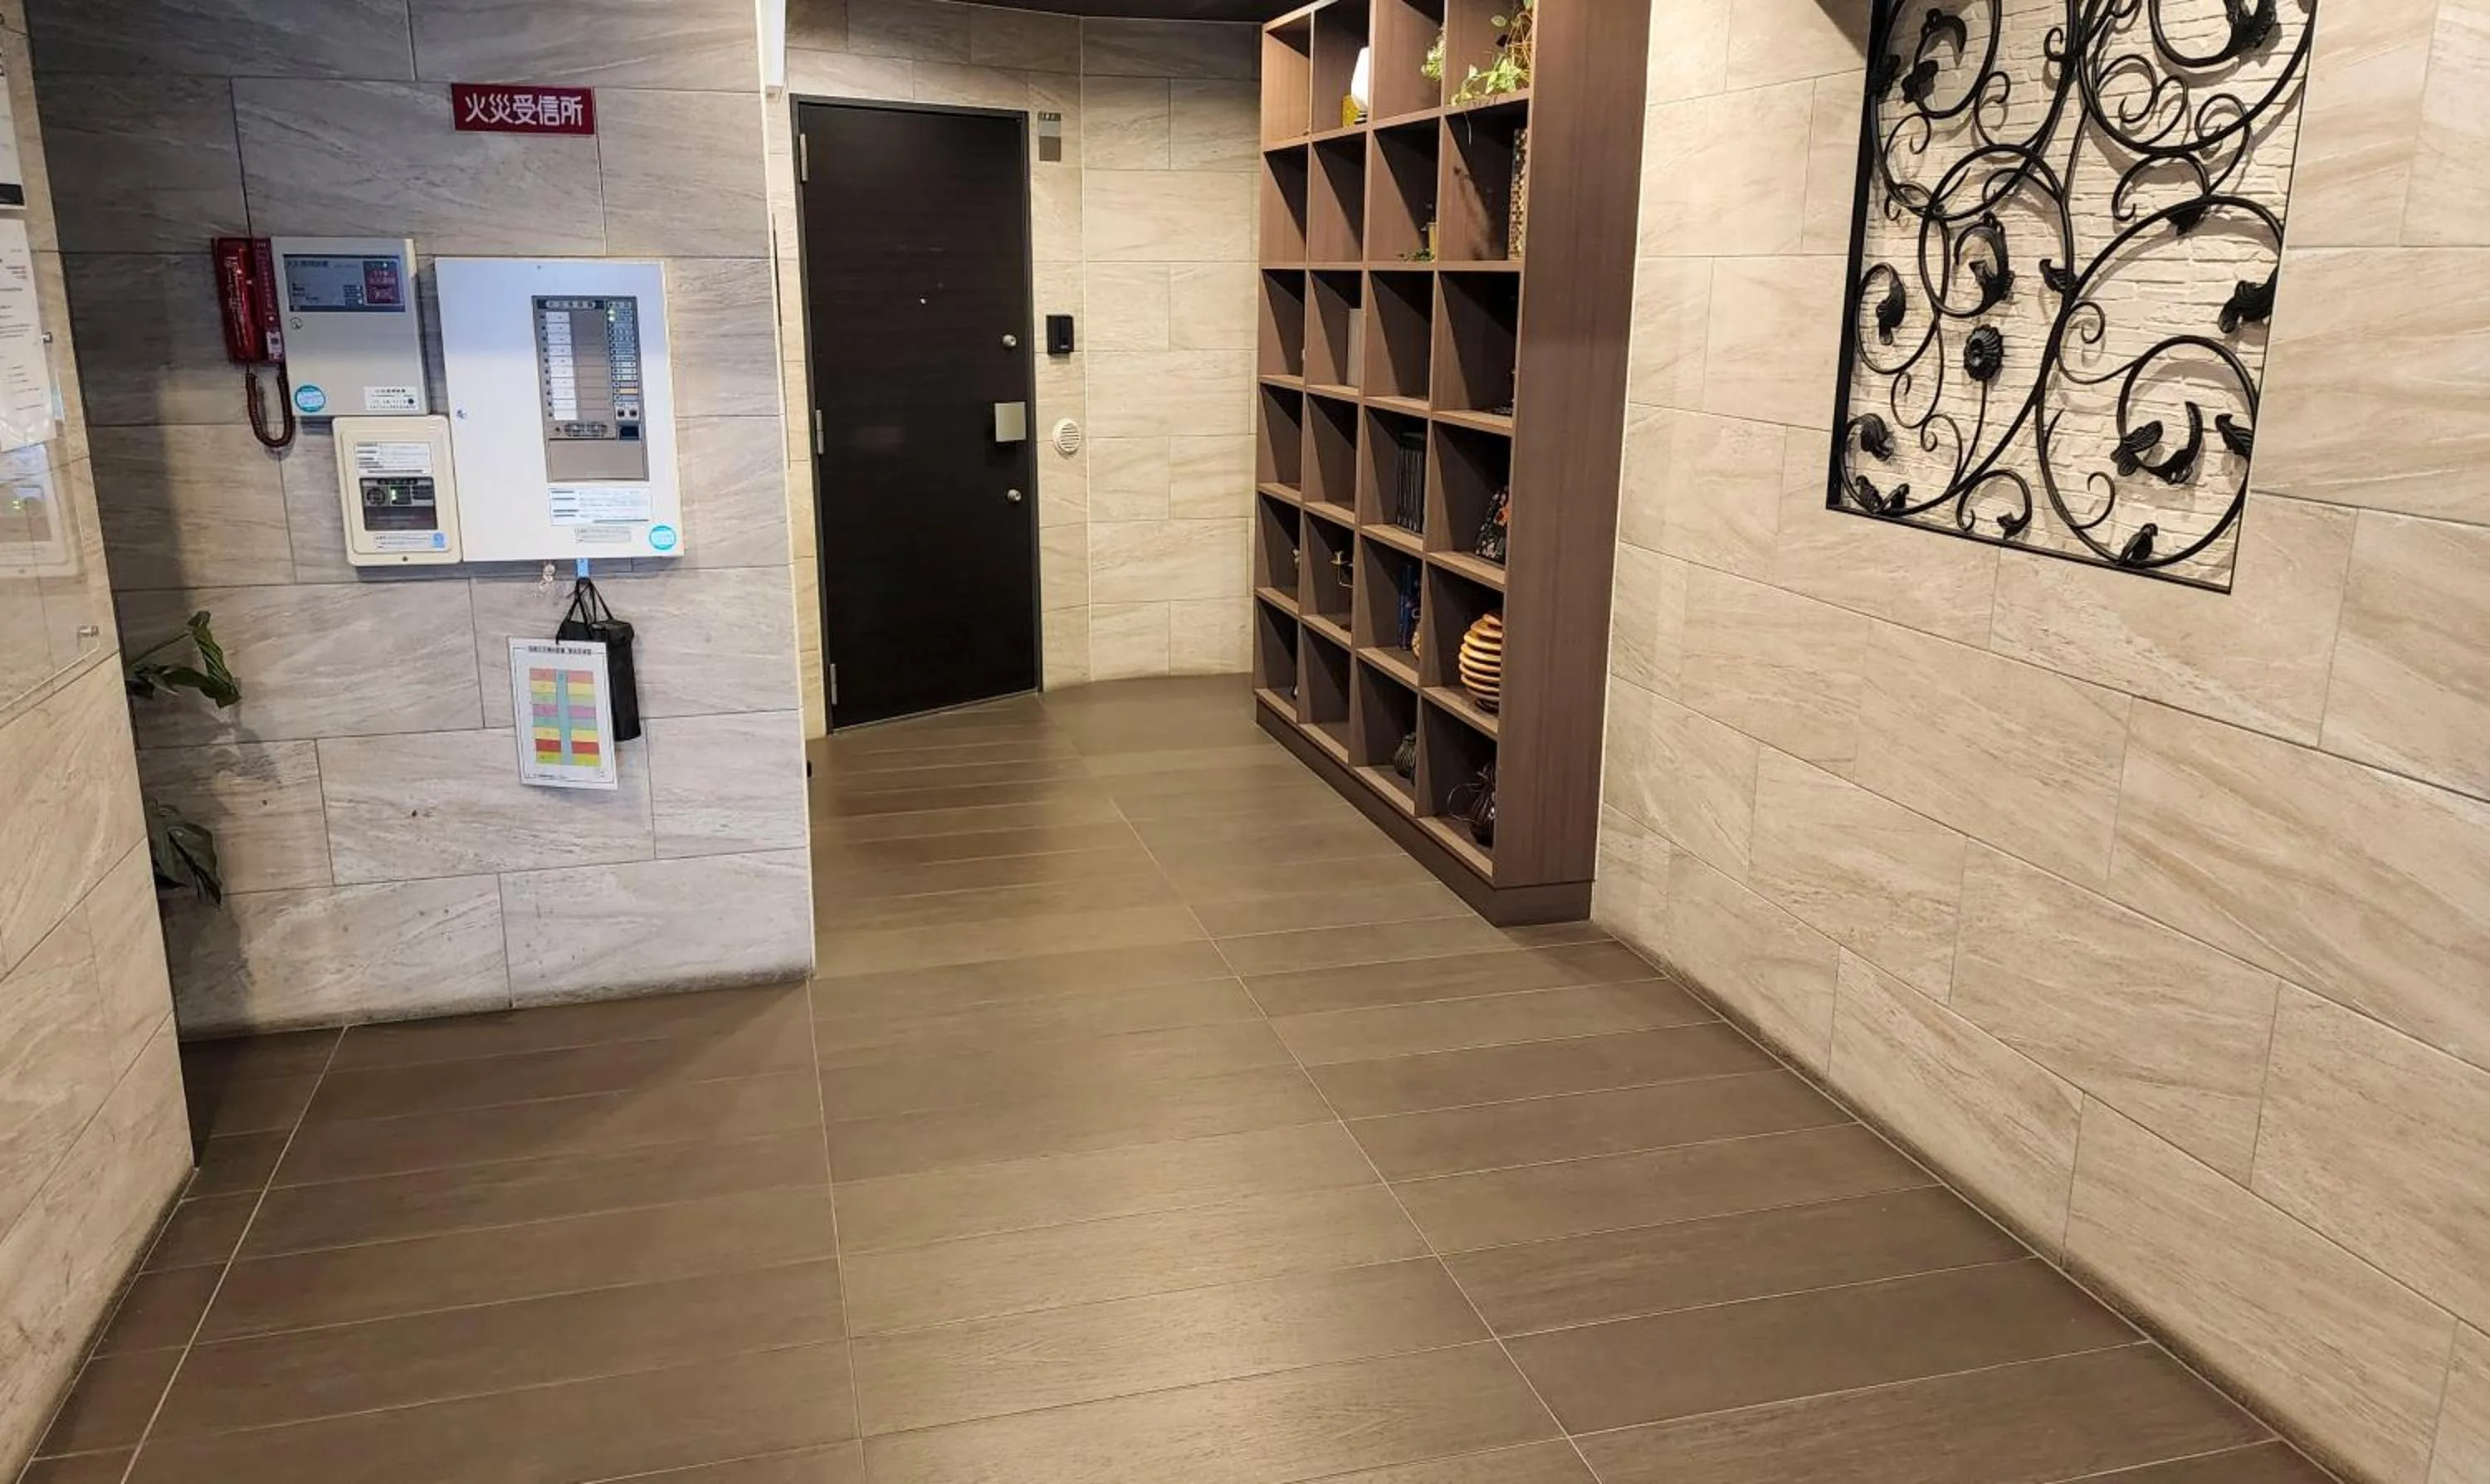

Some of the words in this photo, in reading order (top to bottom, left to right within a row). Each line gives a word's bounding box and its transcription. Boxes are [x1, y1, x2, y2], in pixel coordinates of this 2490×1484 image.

[465, 93, 583, 125] 火災受信所
